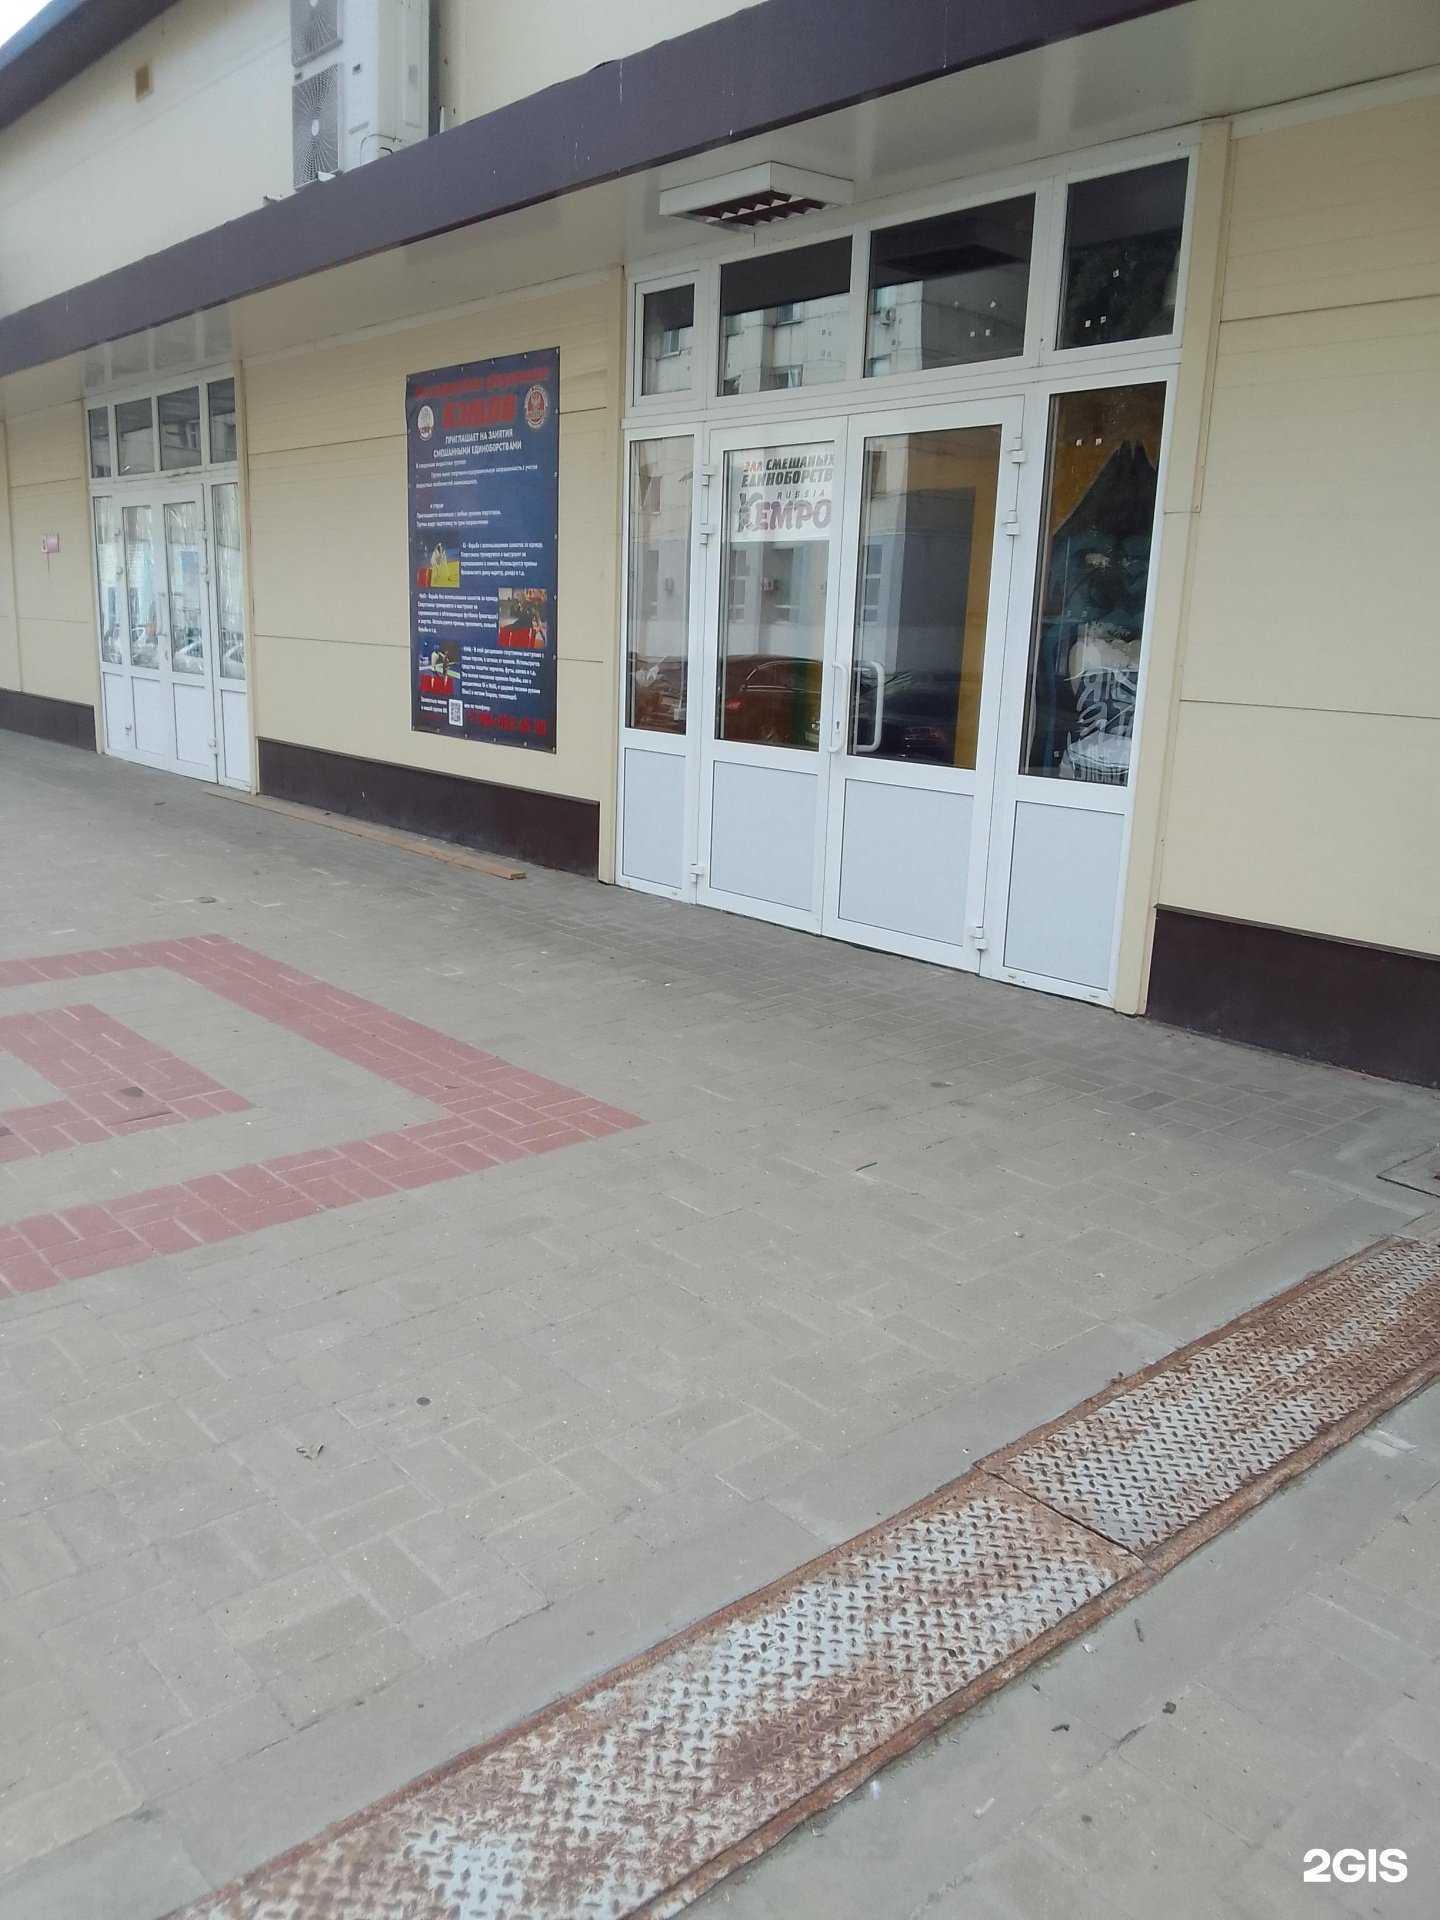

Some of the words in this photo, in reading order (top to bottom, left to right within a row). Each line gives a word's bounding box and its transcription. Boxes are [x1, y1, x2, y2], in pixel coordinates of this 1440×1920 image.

[480, 431, 487, 441] НА
[741, 468, 833, 488] ЕДИНОБОРСТВ
[777, 489, 825, 500] RUSSIA
